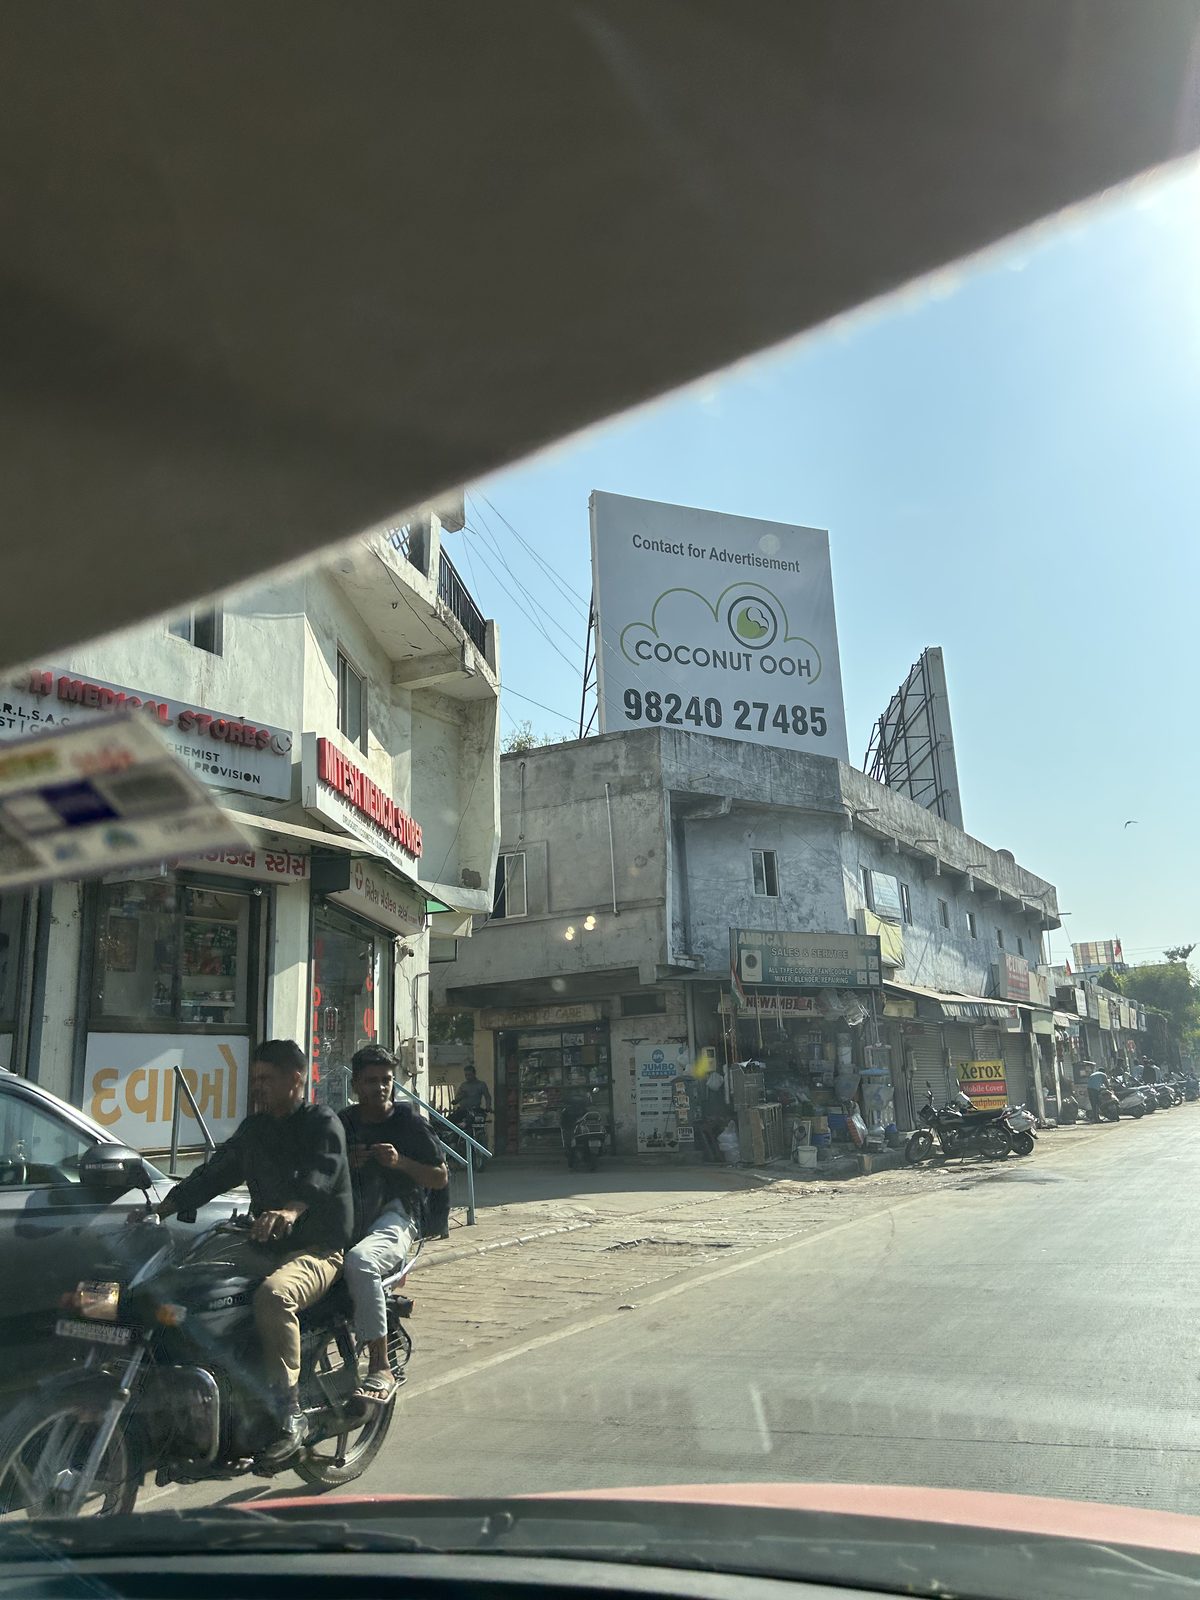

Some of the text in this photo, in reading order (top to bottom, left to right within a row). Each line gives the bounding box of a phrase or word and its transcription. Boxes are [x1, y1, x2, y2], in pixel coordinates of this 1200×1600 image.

[632, 534, 800, 573] Contact for Advertisement
[635, 640, 812, 677] COCONUT OOH
[623, 688, 828, 737] 98240 27485
[178, 709, 272, 751] STORES
[166, 742, 220, 762] CHEMIST
[194, 761, 261, 784] PROVISION
[360, 772, 398, 839] MEDICAL
[771, 947, 801, 958] SALES
[810, 948, 849, 960] SERVICE
[960, 1063, 1003, 1080] Xerox
[963, 1084, 1004, 1093] Mobile Cover
